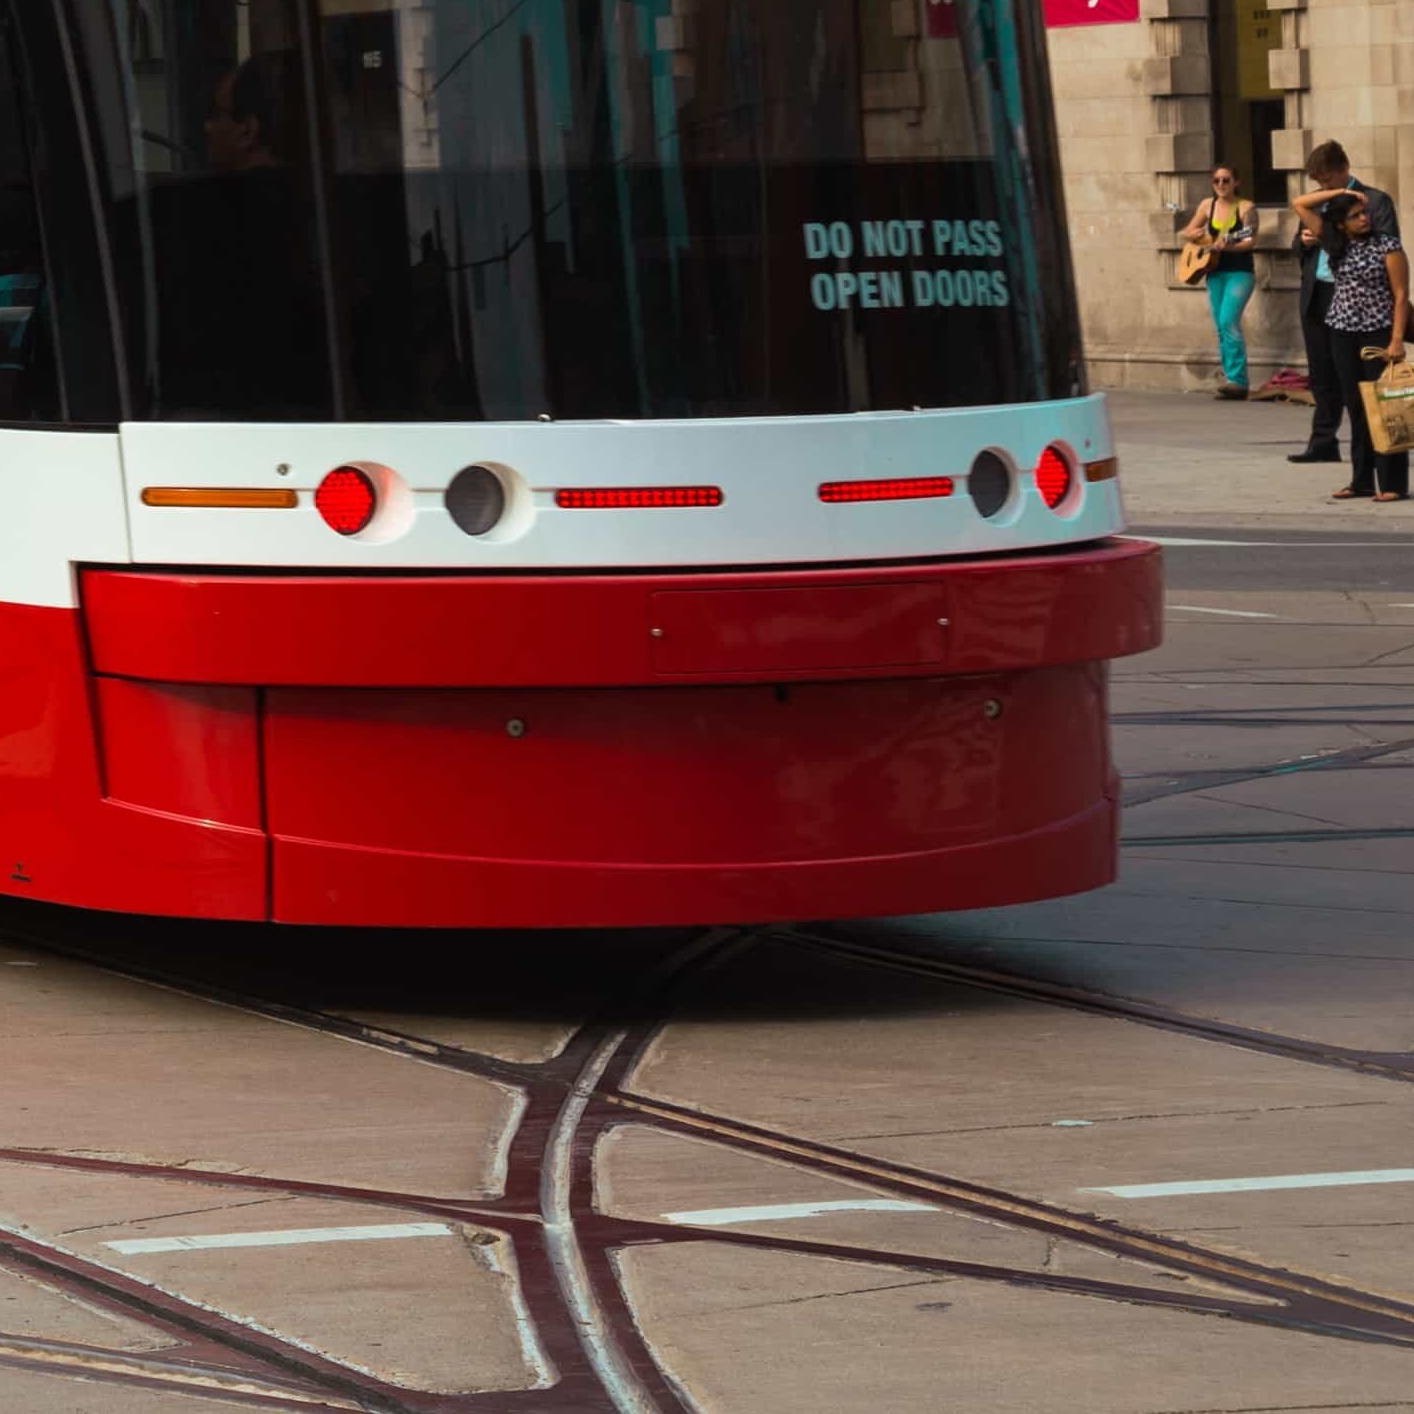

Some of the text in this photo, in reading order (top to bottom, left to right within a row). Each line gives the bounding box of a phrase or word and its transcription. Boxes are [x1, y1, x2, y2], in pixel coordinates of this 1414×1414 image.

[802, 219, 1003, 259] DO NOT PASS
[810, 269, 1010, 311] OPEN DOORS
